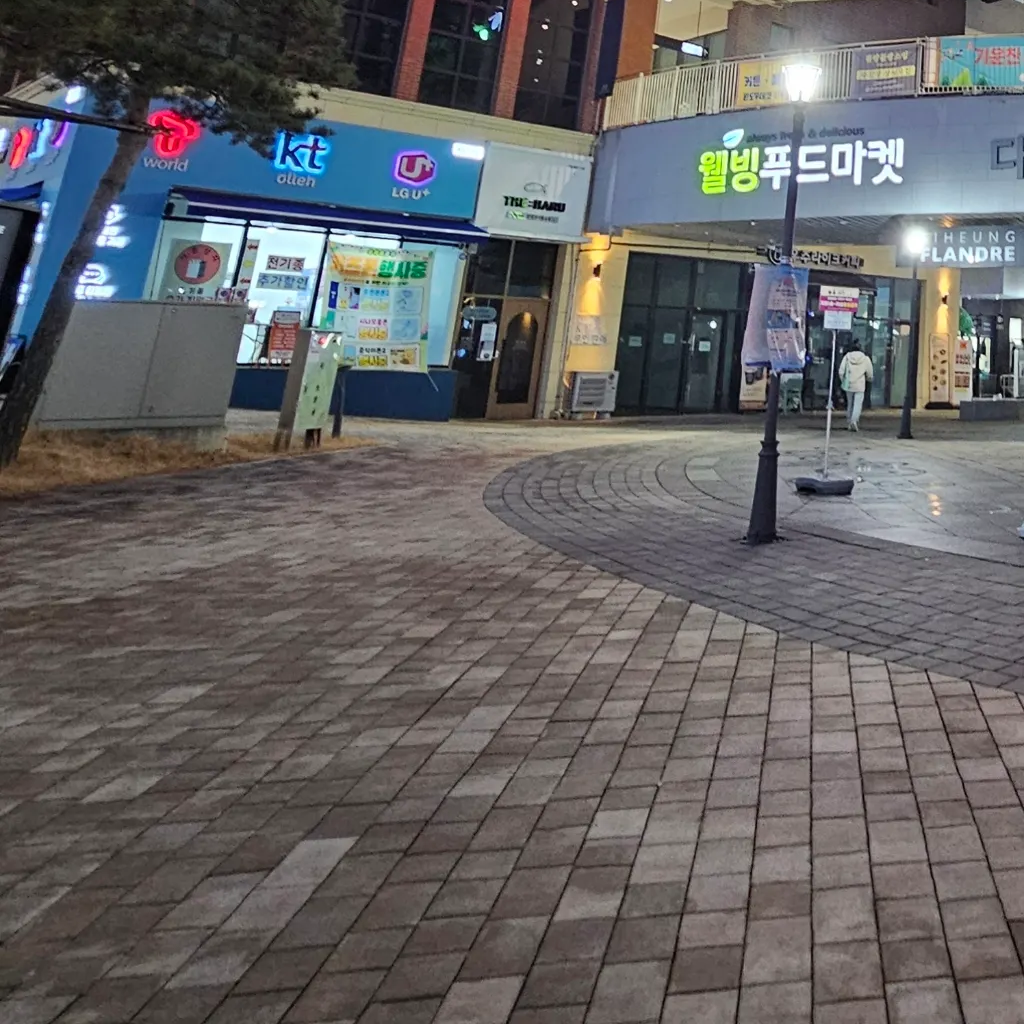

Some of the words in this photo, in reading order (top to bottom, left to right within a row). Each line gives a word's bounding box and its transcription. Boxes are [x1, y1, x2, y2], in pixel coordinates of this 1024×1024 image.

[974, 45, 1022, 68] 기운찬
[279, 131, 327, 172] kt
[142, 158, 189, 173] world
[698, 138, 905, 195] 웰빙푸드마켓
[276, 174, 317, 189] olleh
[391, 187, 409, 198] LG
[411, 188, 431, 201] U+
[920, 245, 1016, 263] FLANDRE
[260, 275, 308, 290] 추가할인
